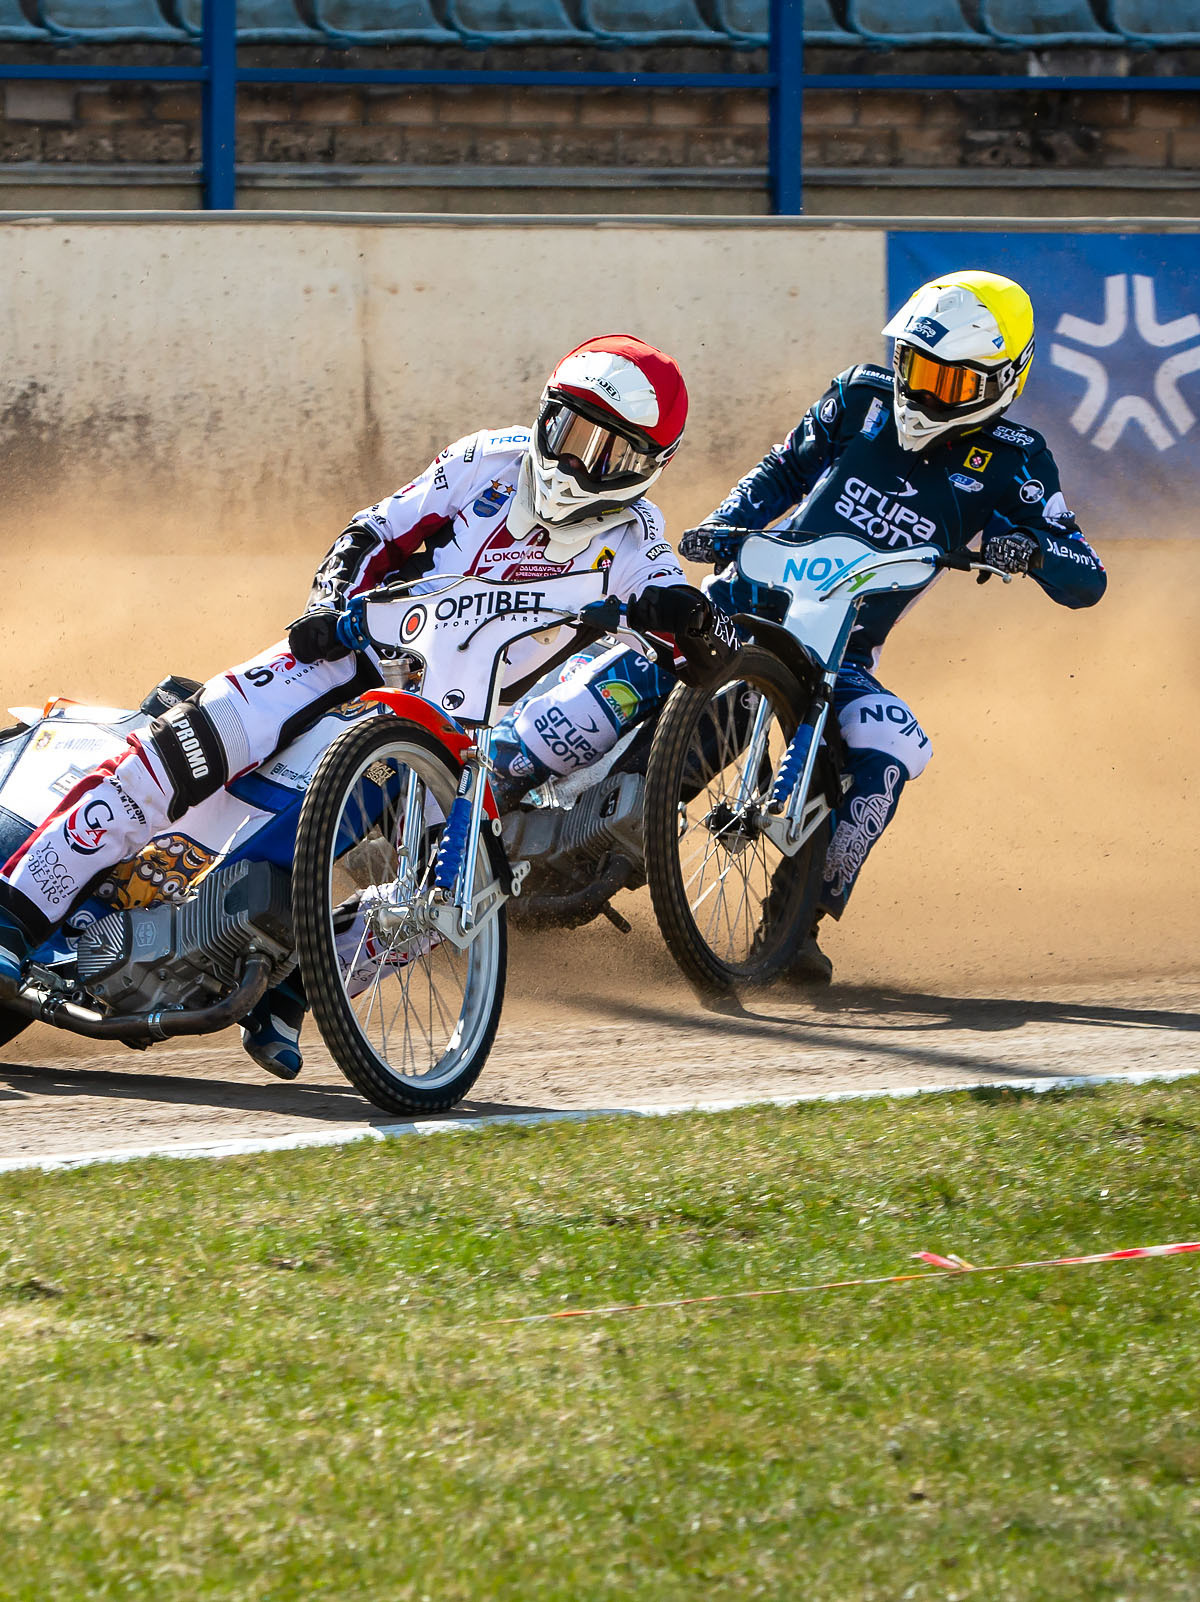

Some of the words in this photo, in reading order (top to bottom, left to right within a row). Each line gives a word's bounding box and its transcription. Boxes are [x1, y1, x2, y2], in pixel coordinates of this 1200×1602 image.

[484, 551, 544, 563] LOKOMO
[435, 591, 546, 621] OPTIBET
[28, 861, 57, 902] BEAR
[40, 840, 79, 897] YOGGI
